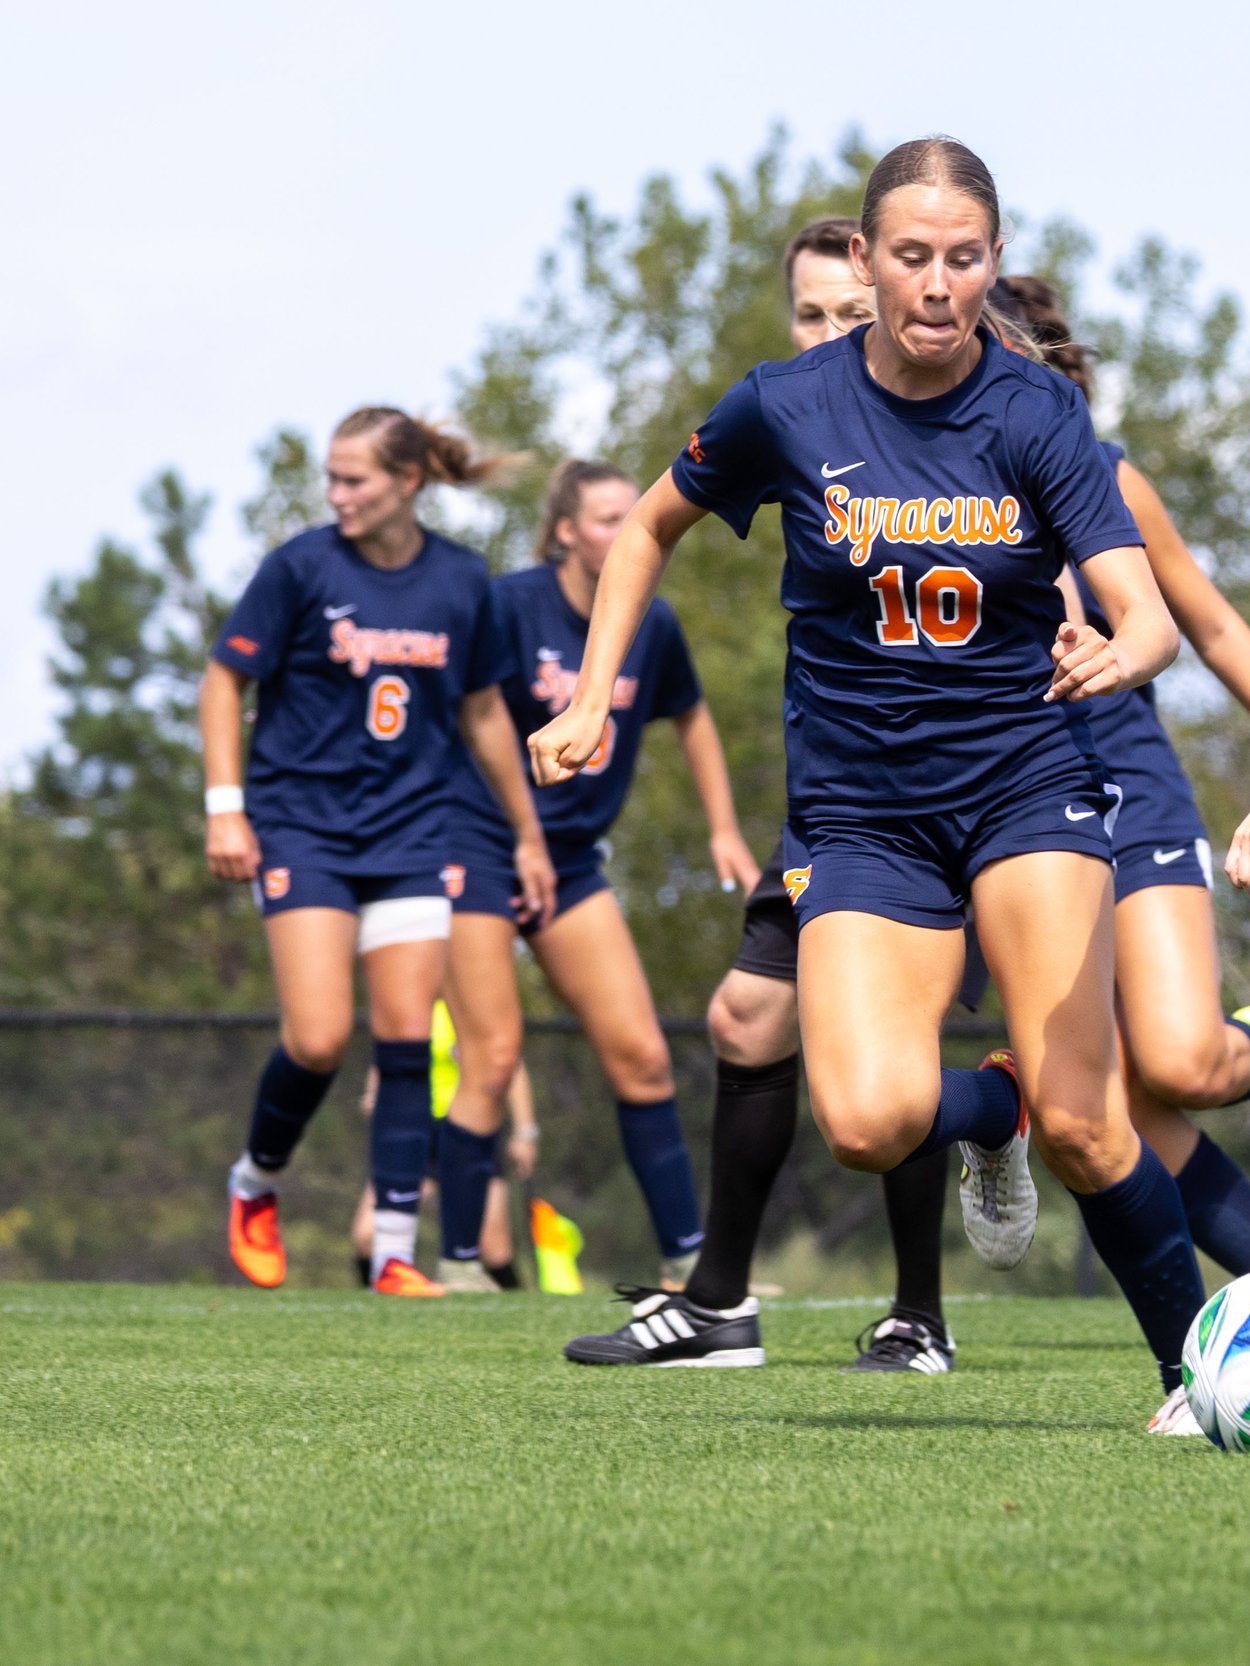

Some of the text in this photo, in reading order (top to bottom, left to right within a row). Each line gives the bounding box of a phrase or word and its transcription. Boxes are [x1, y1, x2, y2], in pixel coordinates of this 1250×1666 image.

[825, 485, 1023, 566] Syracuse
[869, 566, 983, 647] 10
[366, 675, 410, 740] 6
